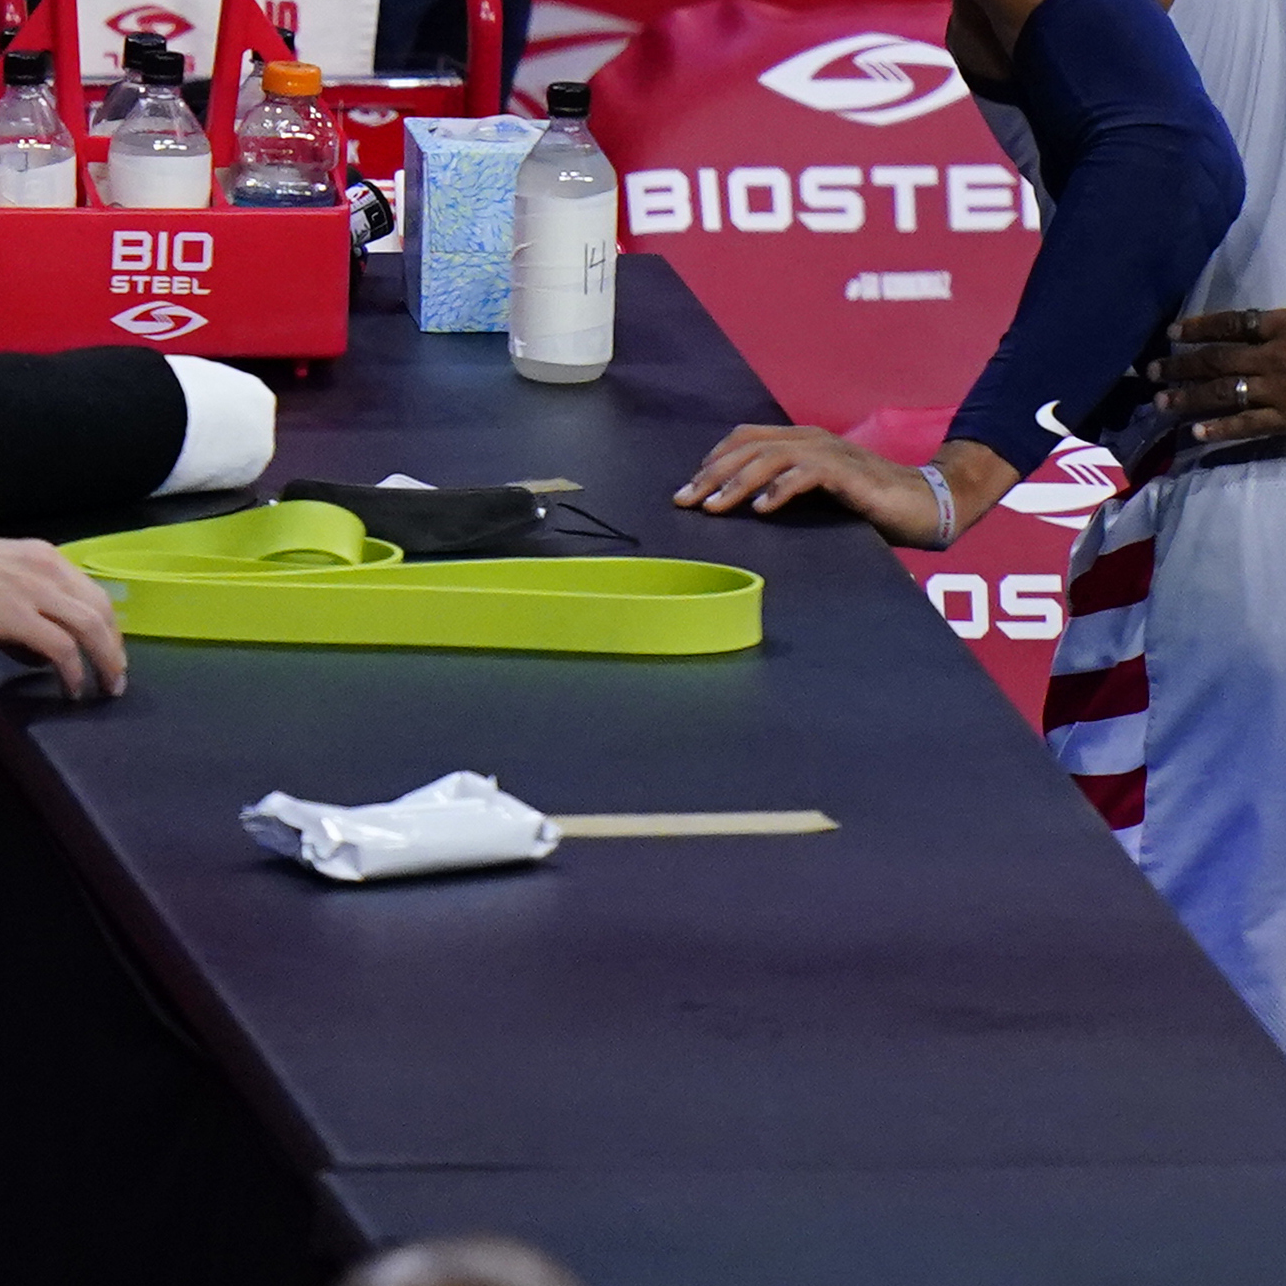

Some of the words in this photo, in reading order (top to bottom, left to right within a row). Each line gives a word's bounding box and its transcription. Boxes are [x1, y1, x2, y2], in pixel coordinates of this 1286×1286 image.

[625, 164, 1041, 236] BIOSTE
[112, 230, 213, 272] BIO
[109, 275, 212, 295] STEEL
